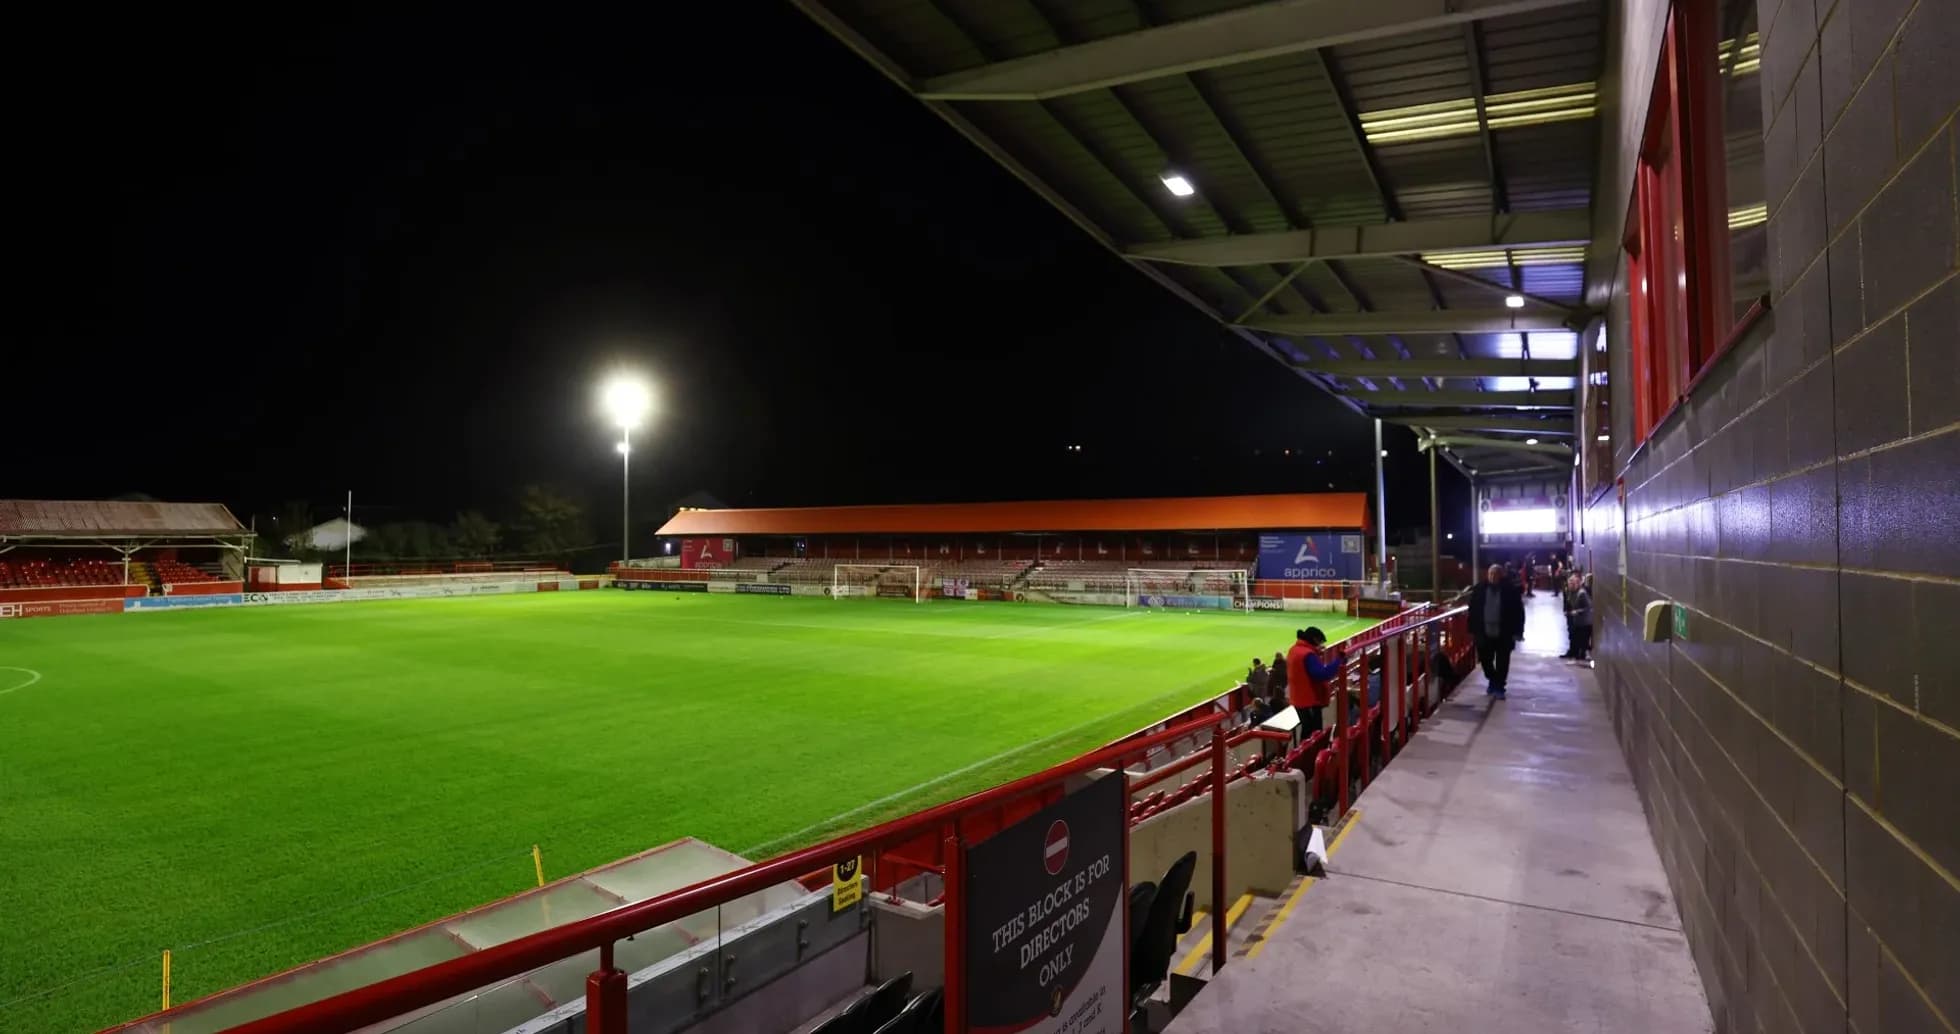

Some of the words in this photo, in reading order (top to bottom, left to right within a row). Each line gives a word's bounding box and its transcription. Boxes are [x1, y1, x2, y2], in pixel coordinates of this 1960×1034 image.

[1284, 566, 1336, 577] apprico
[992, 912, 1025, 953] THIS
[1028, 879, 1073, 929] BLOCK
[1075, 871, 1086, 895] IS
[1088, 854, 1110, 885] FOR
[1020, 897, 1090, 970] DIRECTORS
[1039, 943, 1074, 988] ONLY
